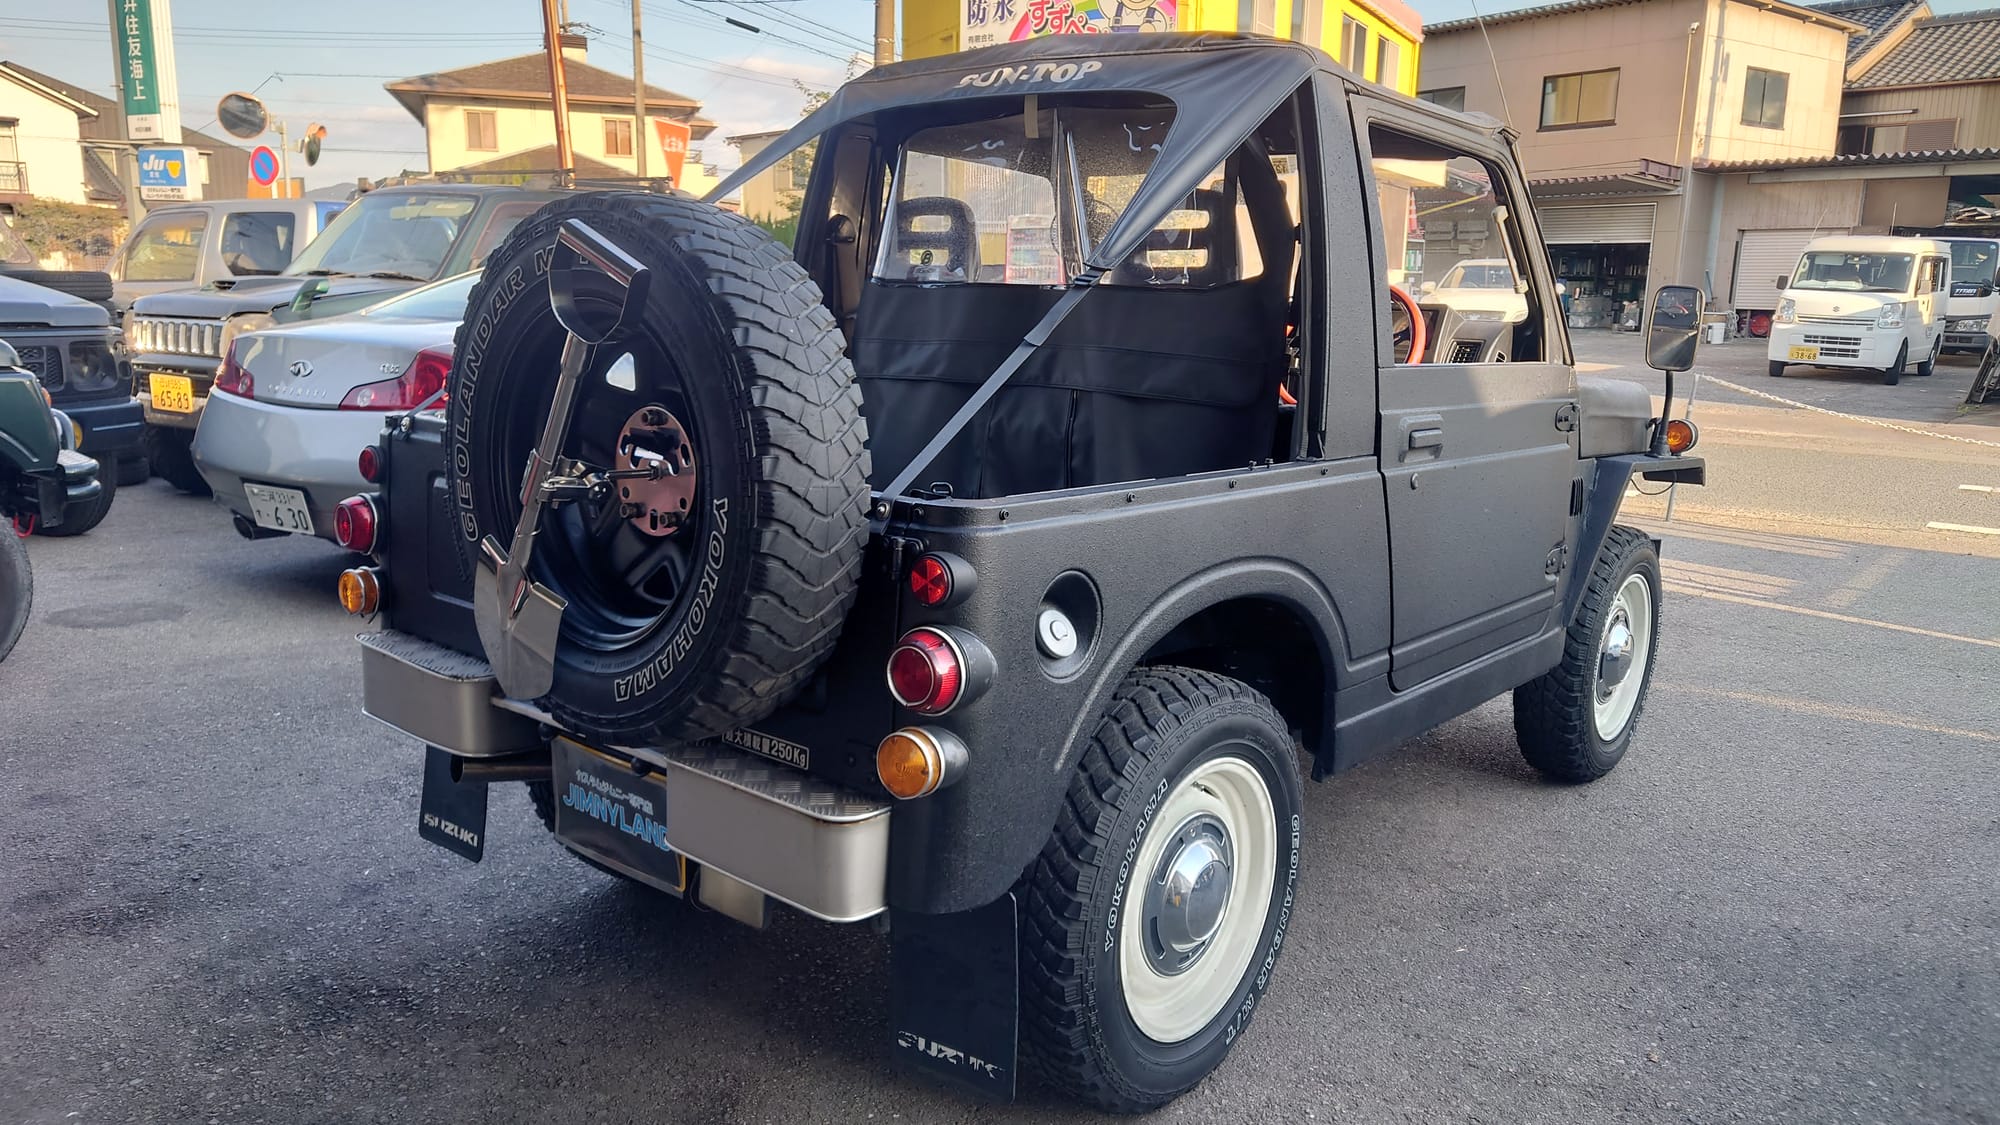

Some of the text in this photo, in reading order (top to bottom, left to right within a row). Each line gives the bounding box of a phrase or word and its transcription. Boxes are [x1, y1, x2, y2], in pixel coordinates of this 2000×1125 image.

[953, 61, 1102, 88] SUN-TOP
[456, 265, 526, 542] GEOLANDAR
[614, 498, 729, 702] YOKOHAMA
[423, 813, 478, 847] SUZUKI
[1104, 778, 1169, 953] YOKOHAMA
[1256, 813, 1300, 991] GEOLANDAR
